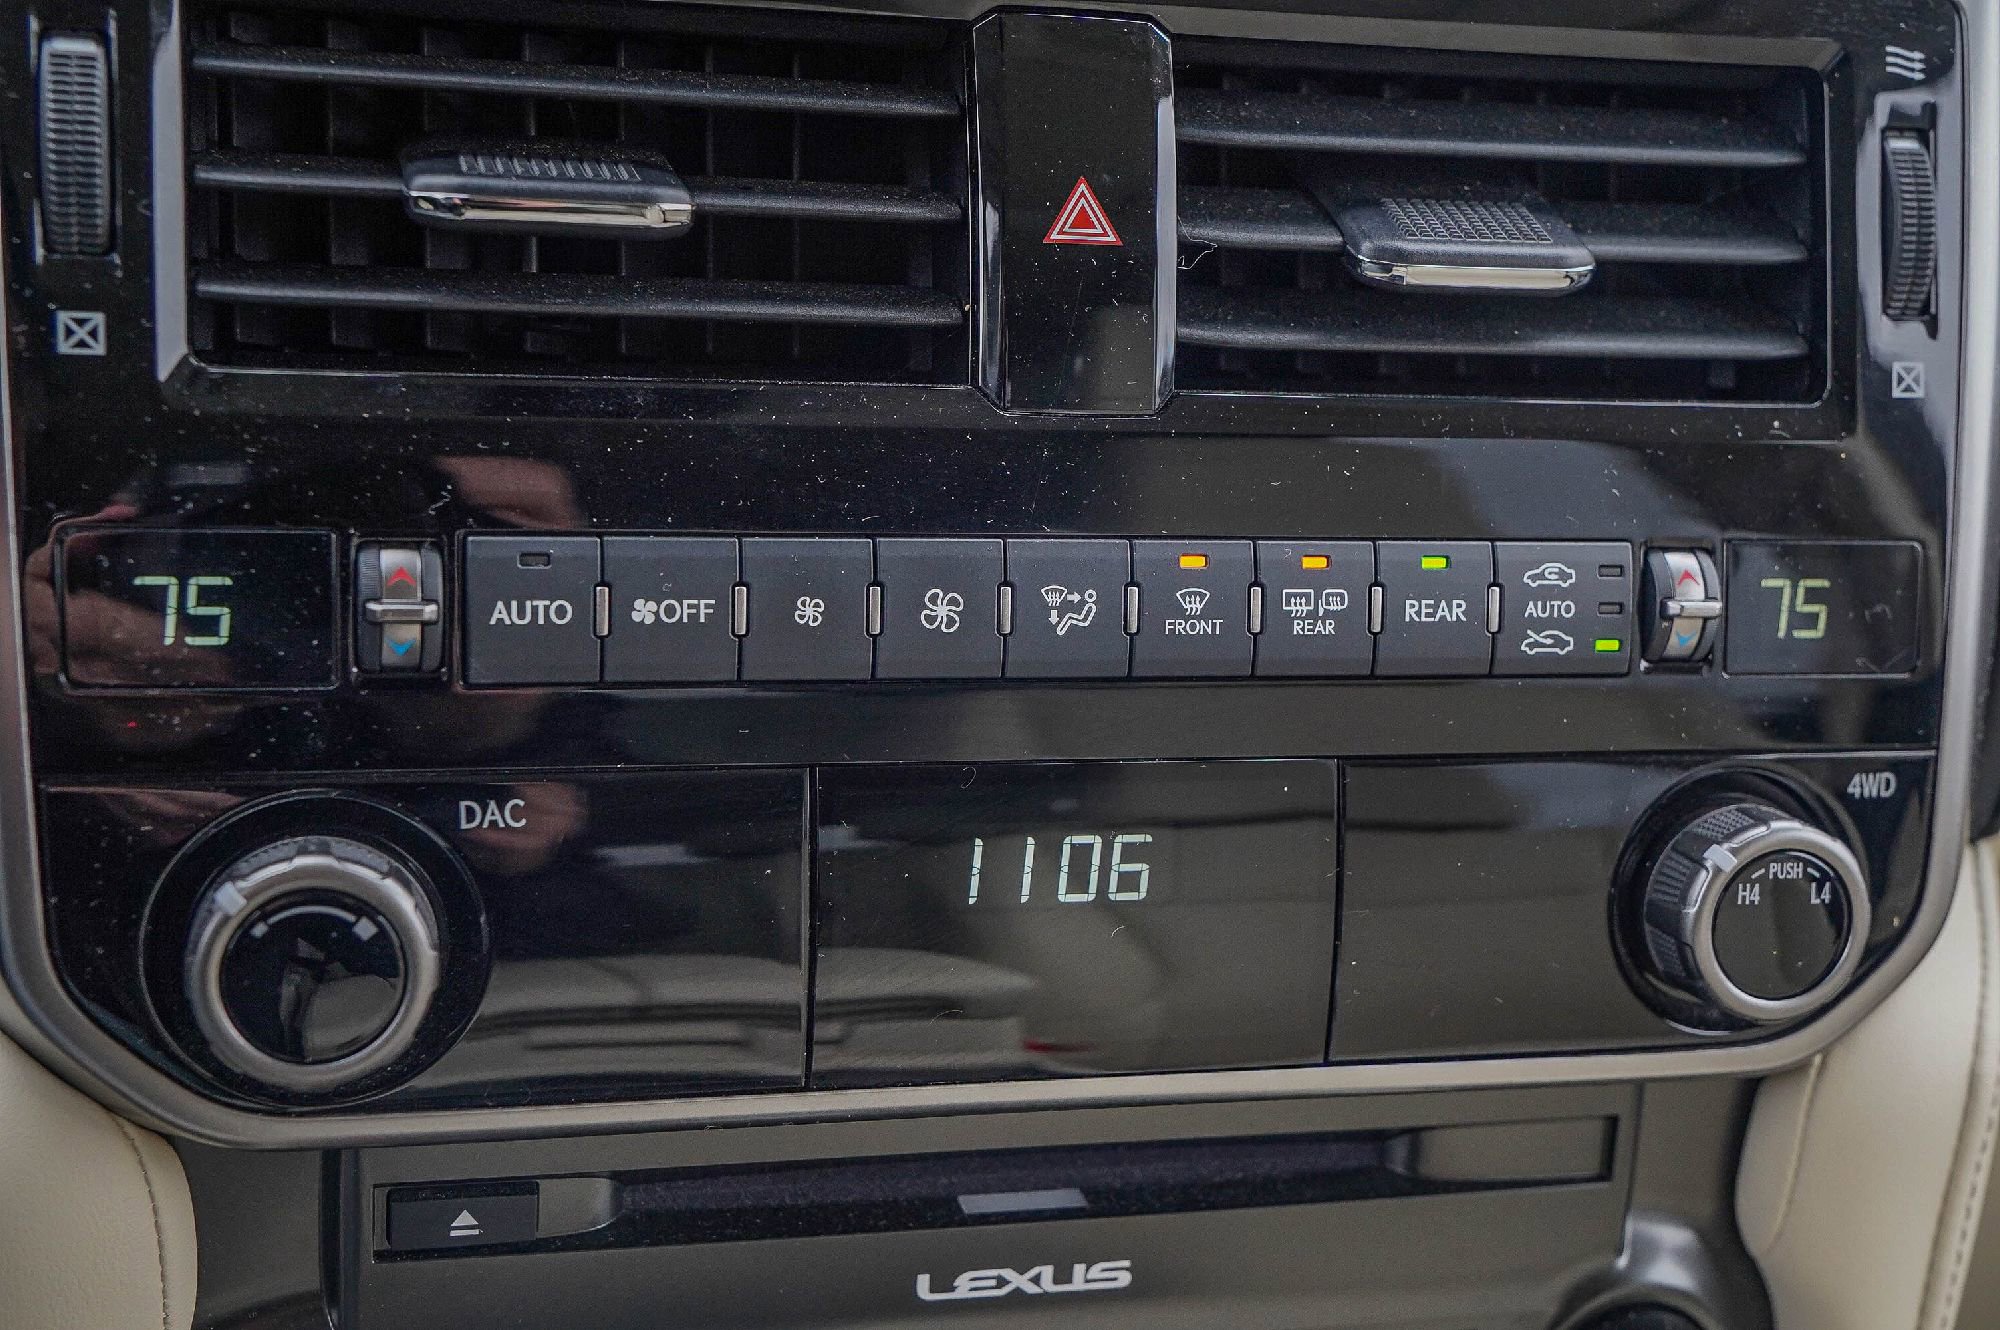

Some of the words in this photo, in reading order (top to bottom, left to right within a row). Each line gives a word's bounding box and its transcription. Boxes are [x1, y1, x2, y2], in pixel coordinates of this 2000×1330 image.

[133, 576, 233, 646] 75
[489, 599, 573, 626] AUTO
[659, 599, 716, 624] OFF
[1404, 599, 1467, 623] REAR
[1524, 600, 1576, 619] AUTO
[1760, 578, 1831, 639] 75
[1164, 619, 1223, 636] FRONT
[1292, 619, 1336, 636] REAR
[1846, 771, 1897, 800] 4WD
[458, 799, 527, 831] DAC
[1768, 861, 1803, 880] PUSH
[1737, 883, 1760, 905] H4
[1809, 882, 1832, 904] L4
[916, 1259, 1133, 1301] LEXUS
